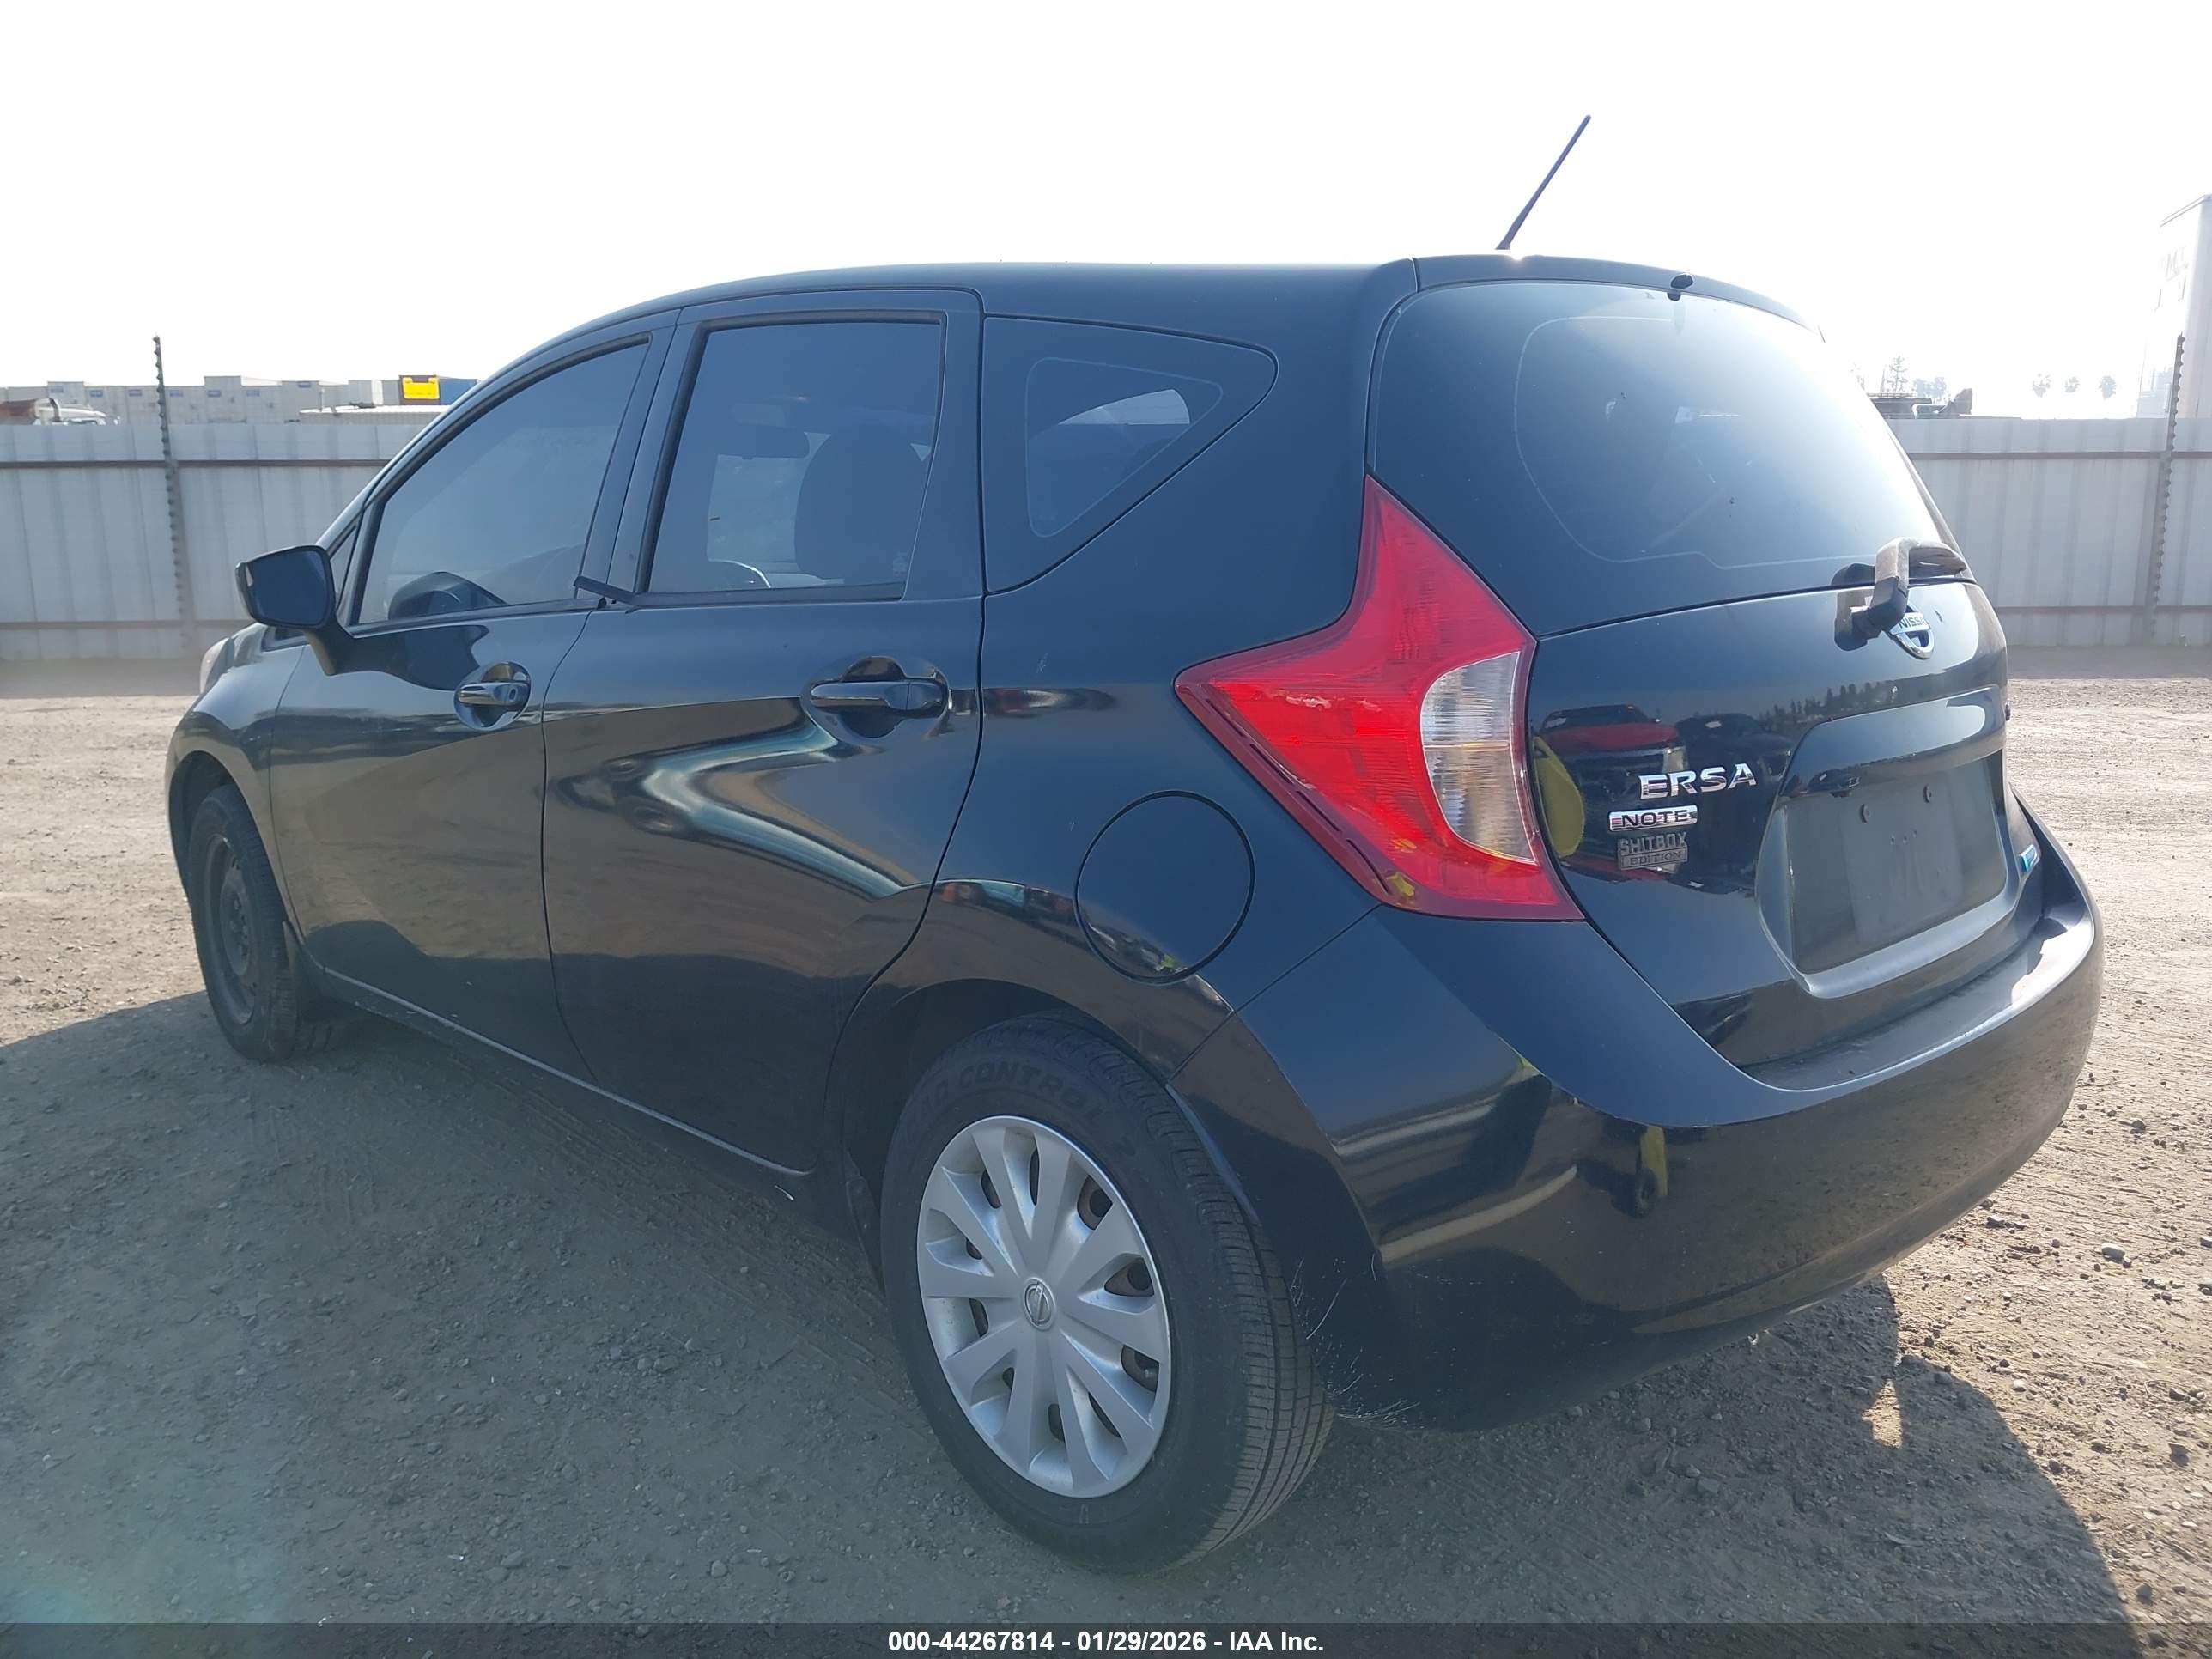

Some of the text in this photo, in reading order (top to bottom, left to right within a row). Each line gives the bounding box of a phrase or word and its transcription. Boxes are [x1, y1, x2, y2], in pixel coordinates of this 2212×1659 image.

[1899, 616, 1926, 629] NISS
[1638, 763, 1757, 799] ERSA
[1622, 809, 1692, 827] NOTE
[1620, 831, 1687, 855] SHITBOX
[1629, 850, 1683, 866] EDITION
